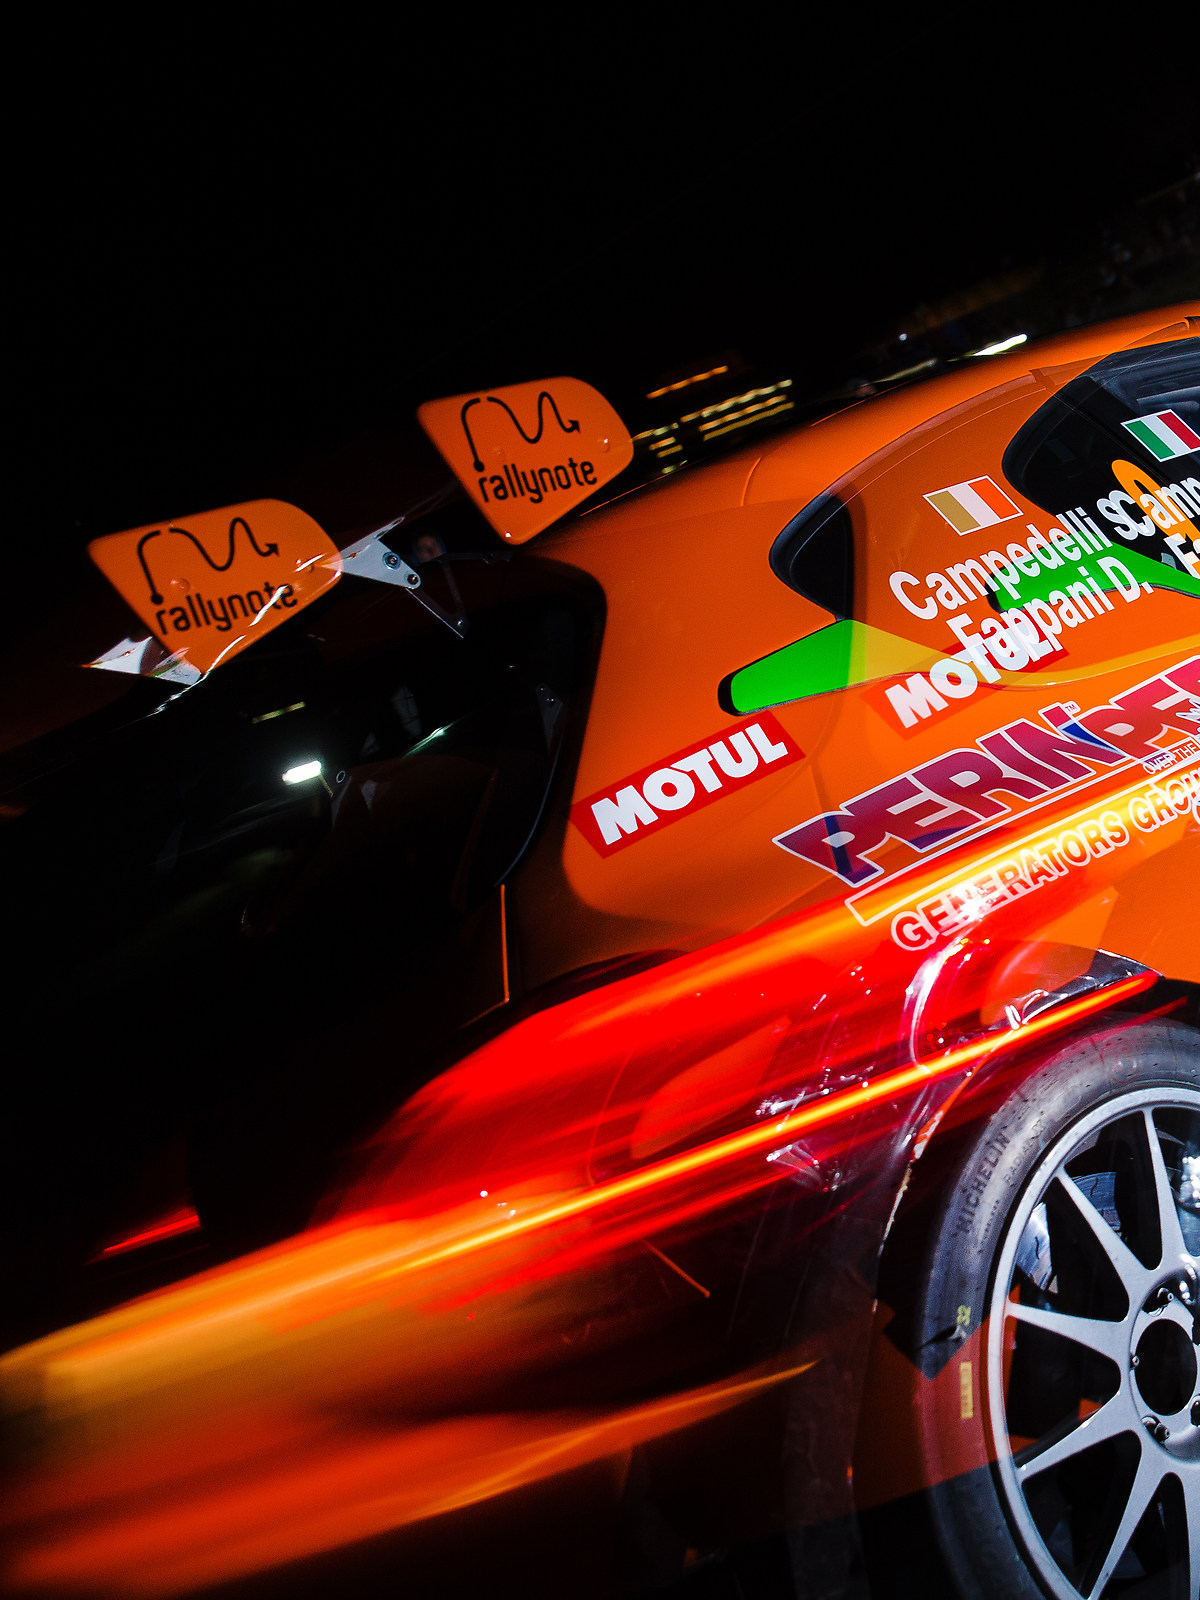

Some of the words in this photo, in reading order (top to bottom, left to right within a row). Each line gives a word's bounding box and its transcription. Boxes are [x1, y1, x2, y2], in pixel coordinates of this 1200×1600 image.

[477, 457, 598, 504] rallynote
[153, 580, 299, 636] rallynote
[889, 503, 1113, 620] Campedelli
[946, 566, 1115, 667] Fappani
[1097, 556, 1154, 603] D.
[590, 723, 789, 845] MOTUL
[772, 702, 1127, 887] PERIN
[1172, 742, 1199, 764] THE
[891, 812, 1130, 952] GENERATORS
